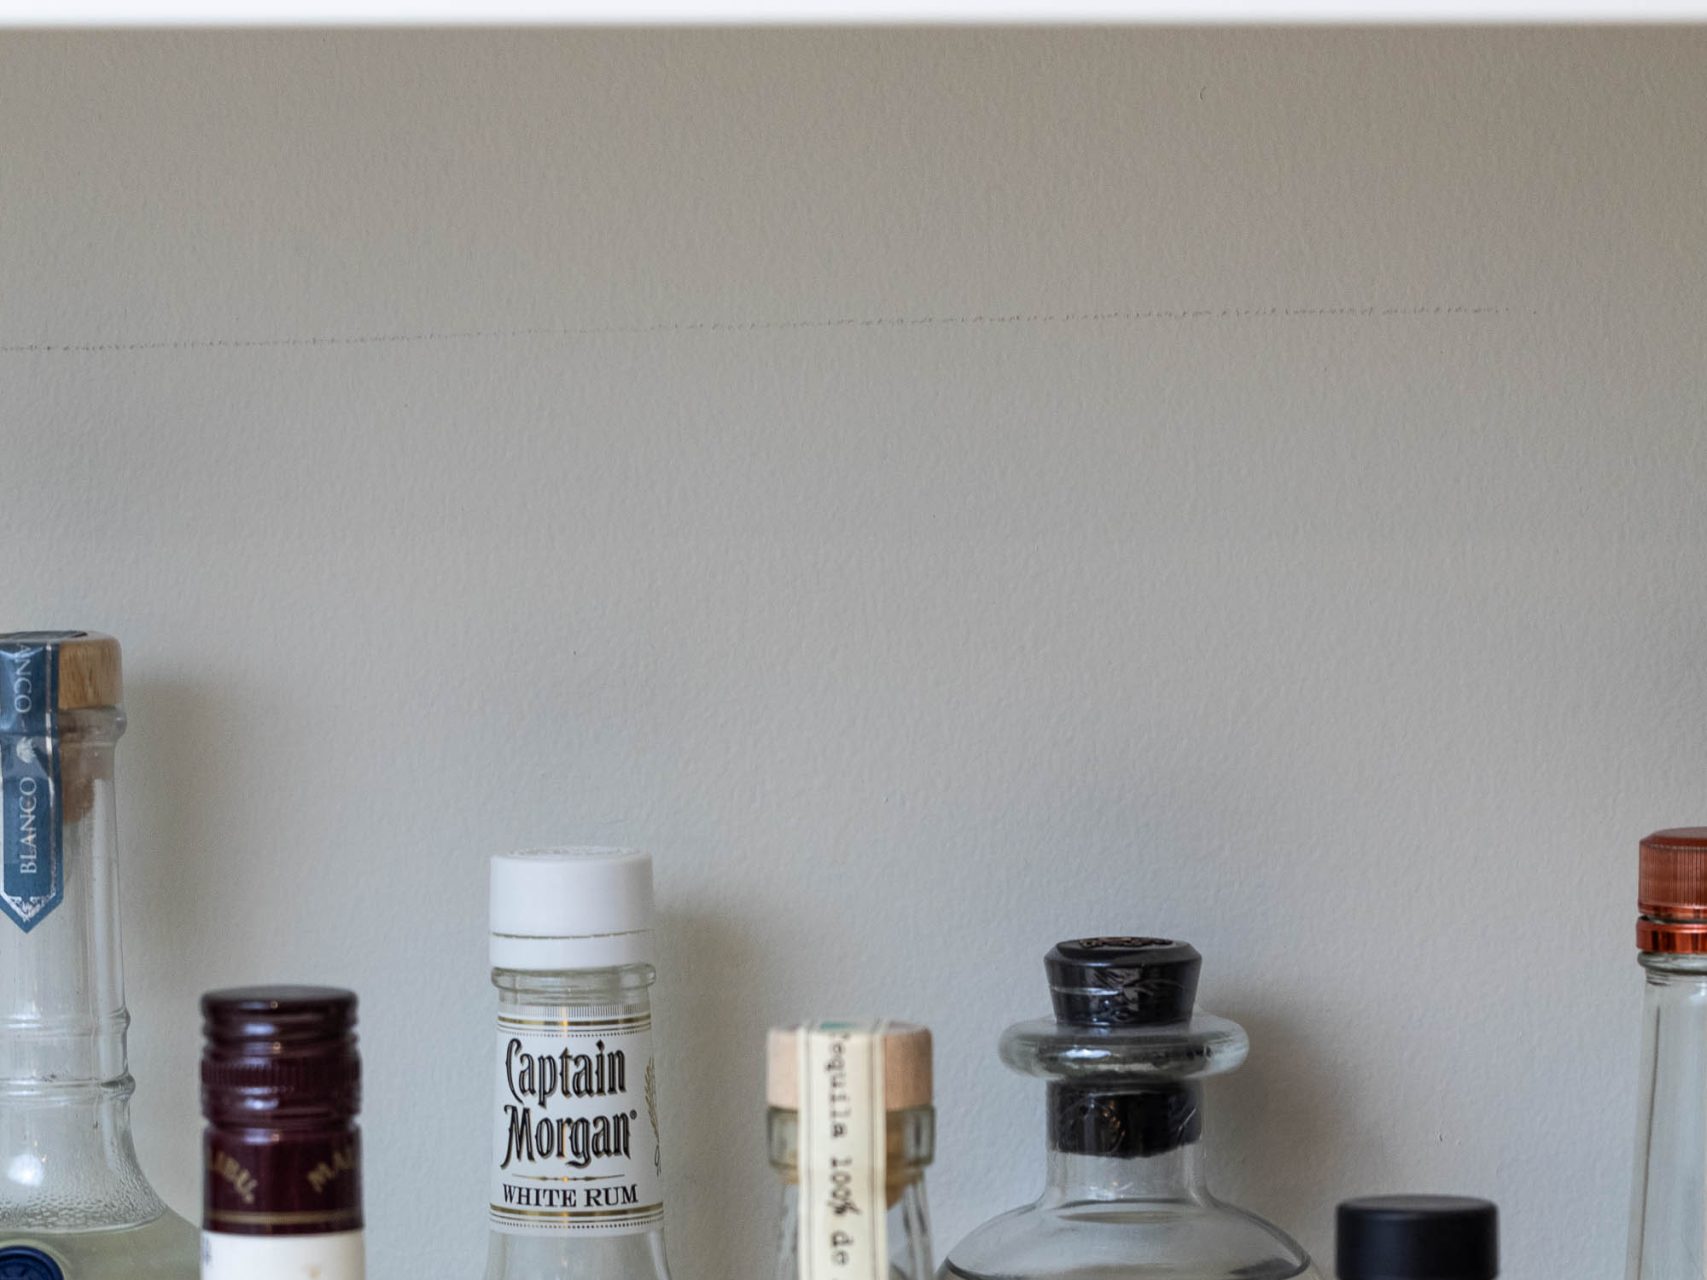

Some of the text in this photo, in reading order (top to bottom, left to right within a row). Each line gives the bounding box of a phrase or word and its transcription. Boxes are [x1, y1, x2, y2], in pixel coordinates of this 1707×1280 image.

[19, 776, 37, 875] BLANCO
[504, 1037, 627, 1109] Captain
[500, 1103, 637, 1170] Morgan
[502, 1183, 639, 1208] WHITE RUM
[828, 1157, 862, 1216] 100%
[829, 1230, 854, 1267] de
